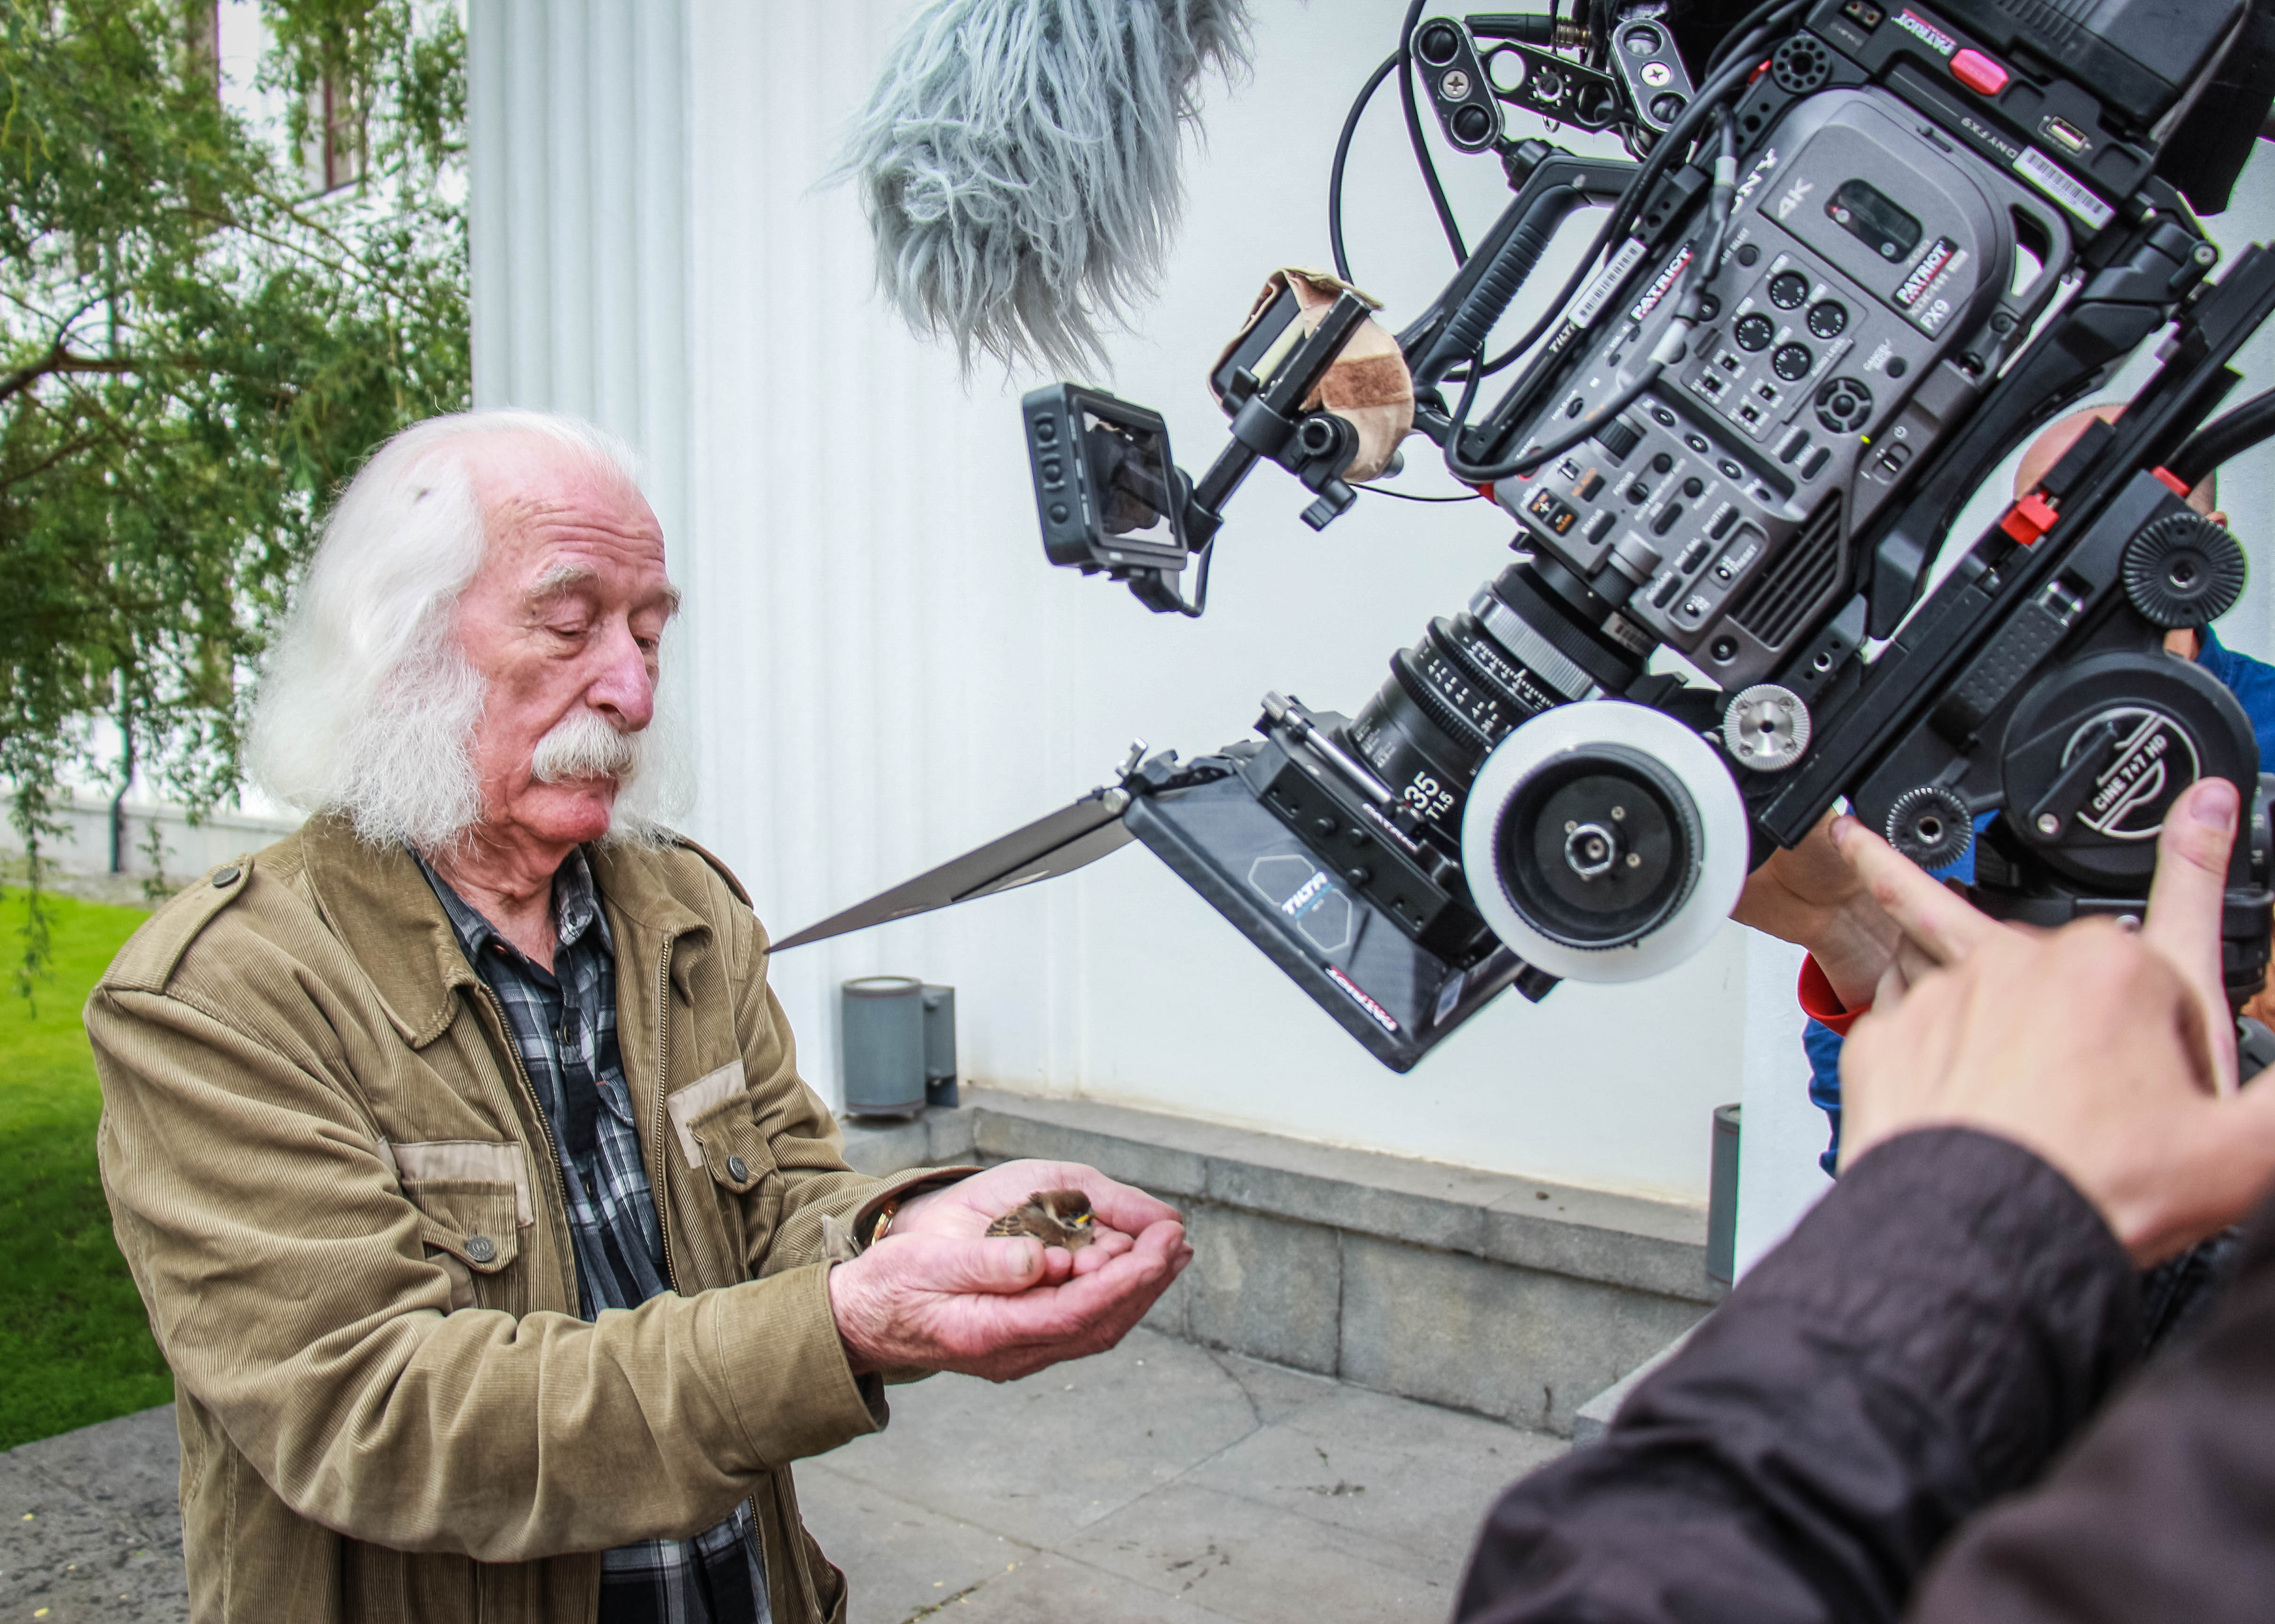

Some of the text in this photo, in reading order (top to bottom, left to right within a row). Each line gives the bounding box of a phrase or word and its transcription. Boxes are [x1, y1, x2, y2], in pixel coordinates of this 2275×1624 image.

[1891, 9, 1954, 56] PATRIOT
[1960, 116, 2018, 159] ONY FX9
[1778, 178, 1813, 219] 4K
[1631, 247, 1691, 320] PATRIOT
[1896, 242, 1947, 304] PATRIOT
[1919, 296, 1952, 331] FX9
[1404, 771, 1440, 809] 35
[2092, 778, 2126, 812] CINE
[2144, 734, 2169, 758] HD
[1425, 790, 1455, 820] T1.5
[1280, 871, 1328, 914] TILTA
[1325, 967, 1397, 1031] PATRIOT
